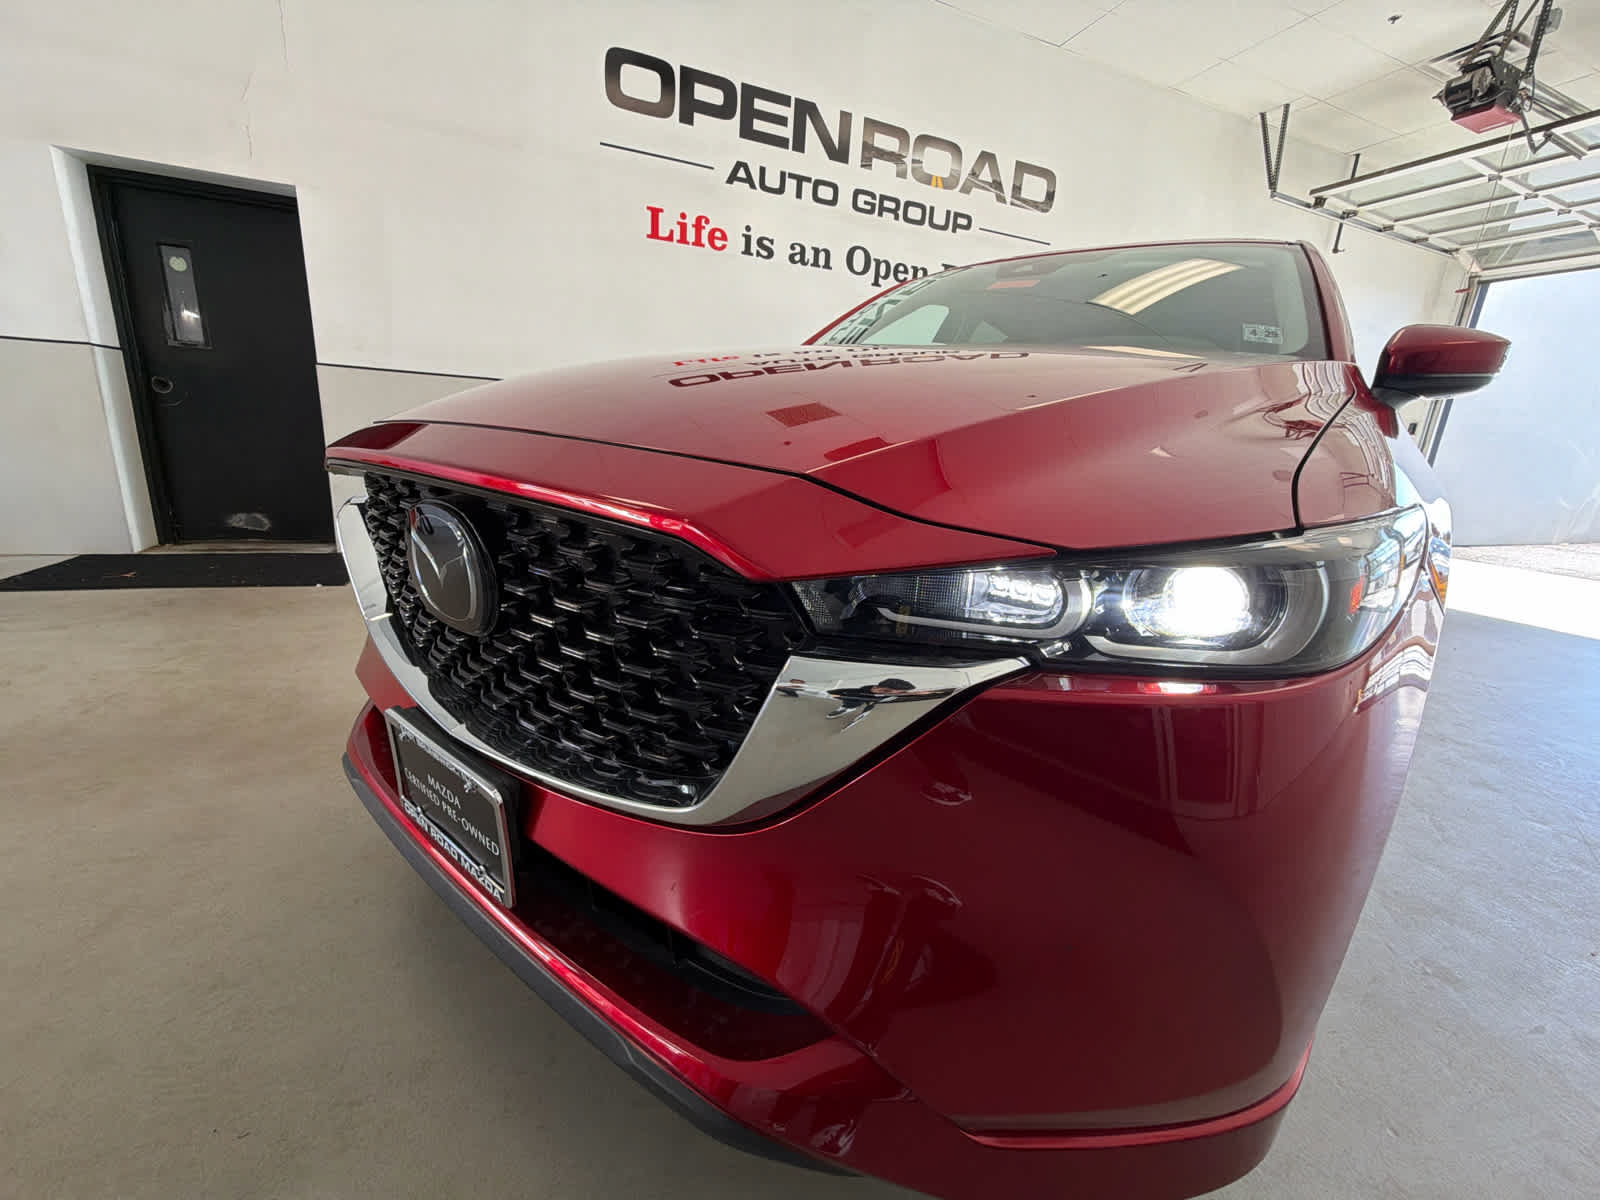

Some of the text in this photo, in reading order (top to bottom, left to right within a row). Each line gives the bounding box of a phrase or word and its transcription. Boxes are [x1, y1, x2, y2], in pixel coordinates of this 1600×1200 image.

[725, 160, 973, 234] AUTO GROUP
[645, 205, 929, 287] Life is an Open
[403, 767, 500, 856] CERTIFIED PRE-OWNED
[427, 773, 461, 809] MAZDA
[430, 827, 459, 861] ROAD
[460, 856, 504, 904] MAZDA
